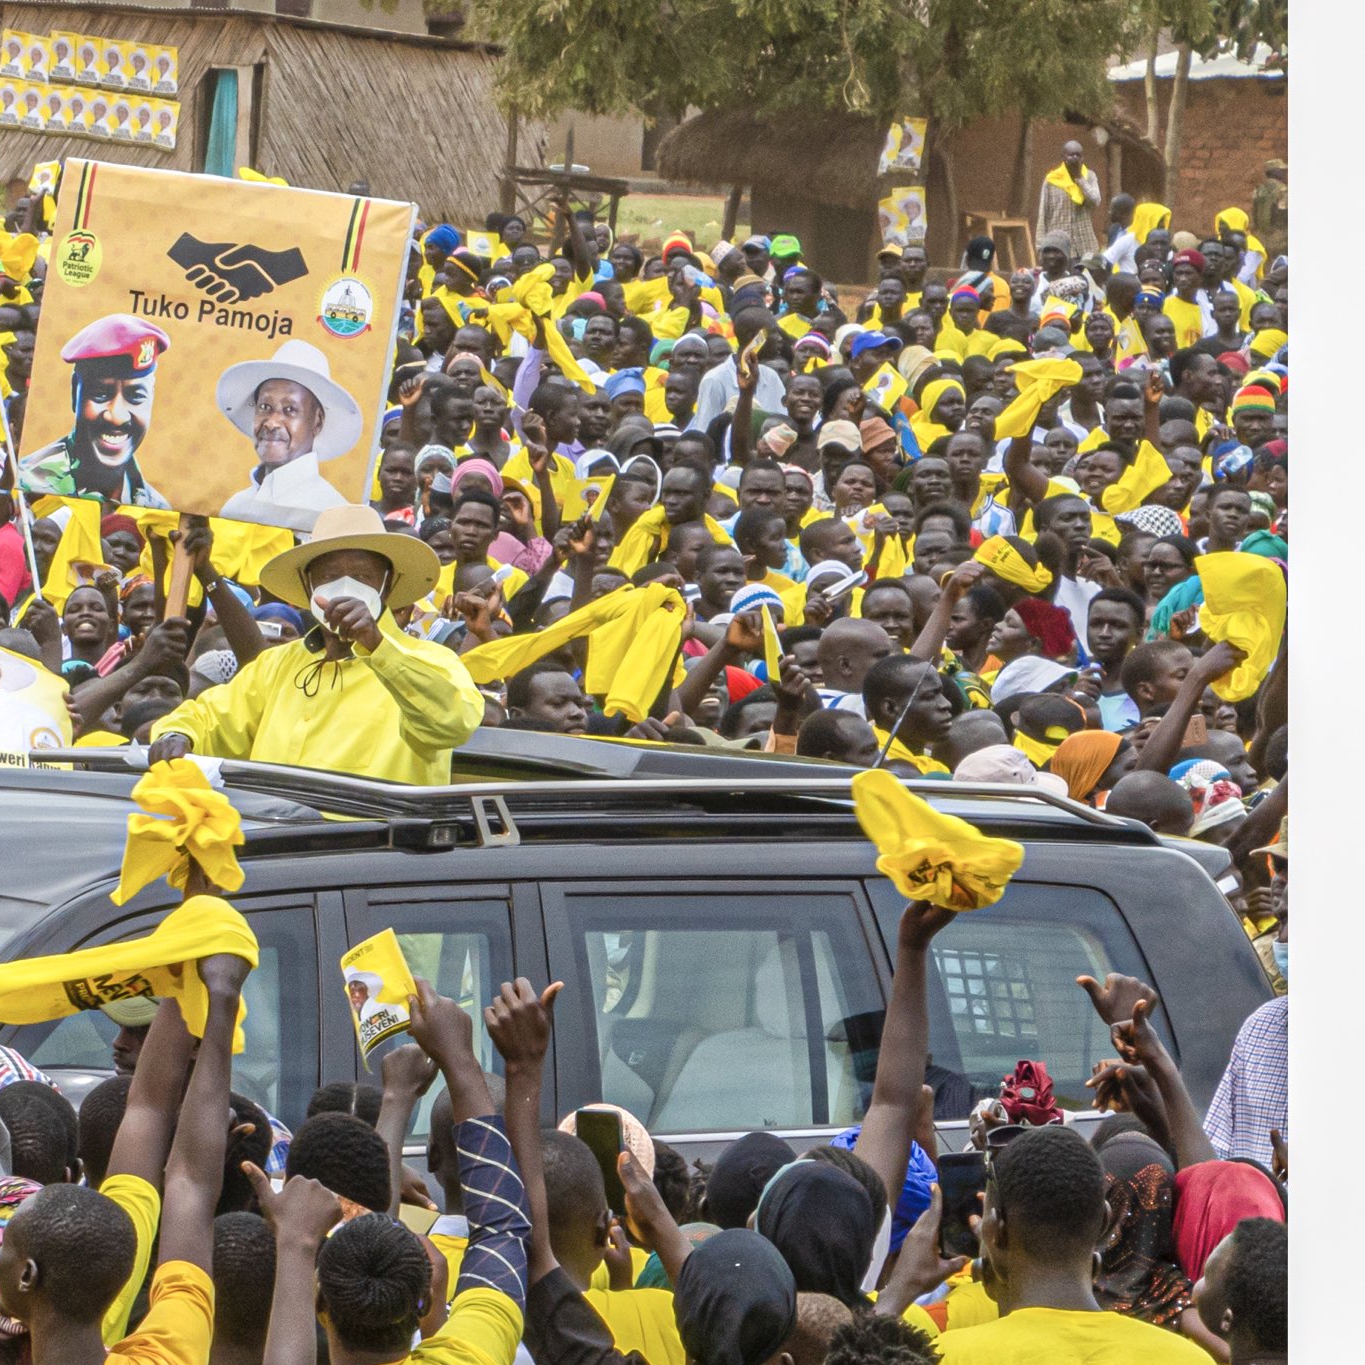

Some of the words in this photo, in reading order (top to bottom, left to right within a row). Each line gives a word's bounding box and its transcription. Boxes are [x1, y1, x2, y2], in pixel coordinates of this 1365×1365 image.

[62, 261, 93, 273] Patriotic
[64, 269, 90, 279] League
[129, 289, 189, 320] Tuko
[198, 299, 293, 339] Pamoja
